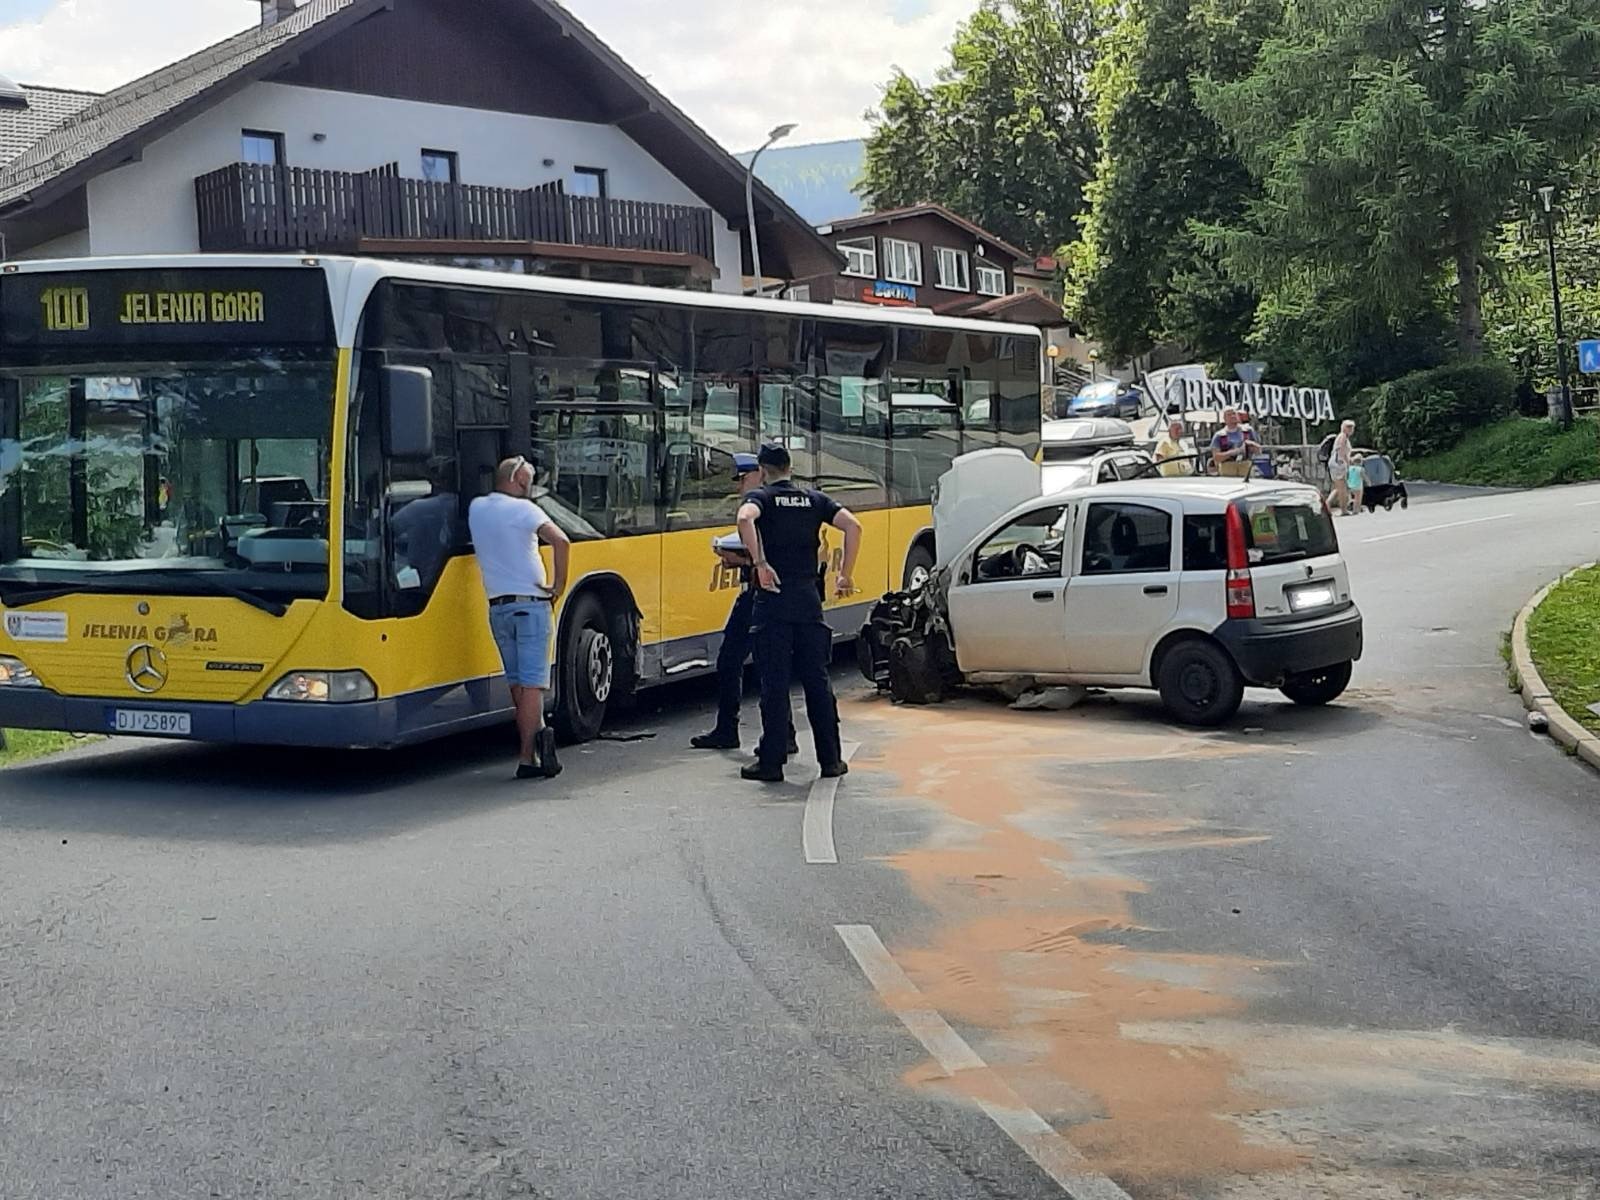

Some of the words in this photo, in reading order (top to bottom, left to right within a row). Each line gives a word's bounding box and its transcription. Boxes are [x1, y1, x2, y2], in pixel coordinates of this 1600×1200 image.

[40, 287, 89, 330] 100
[120, 292, 206, 323] JELENIA
[1184, 378, 1335, 426] RESTAURACJA
[775, 496, 812, 508] POLICJA
[82, 624, 149, 640] JELENIA
[118, 712, 136, 729] DJ
[143, 713, 188, 731] 2589C
